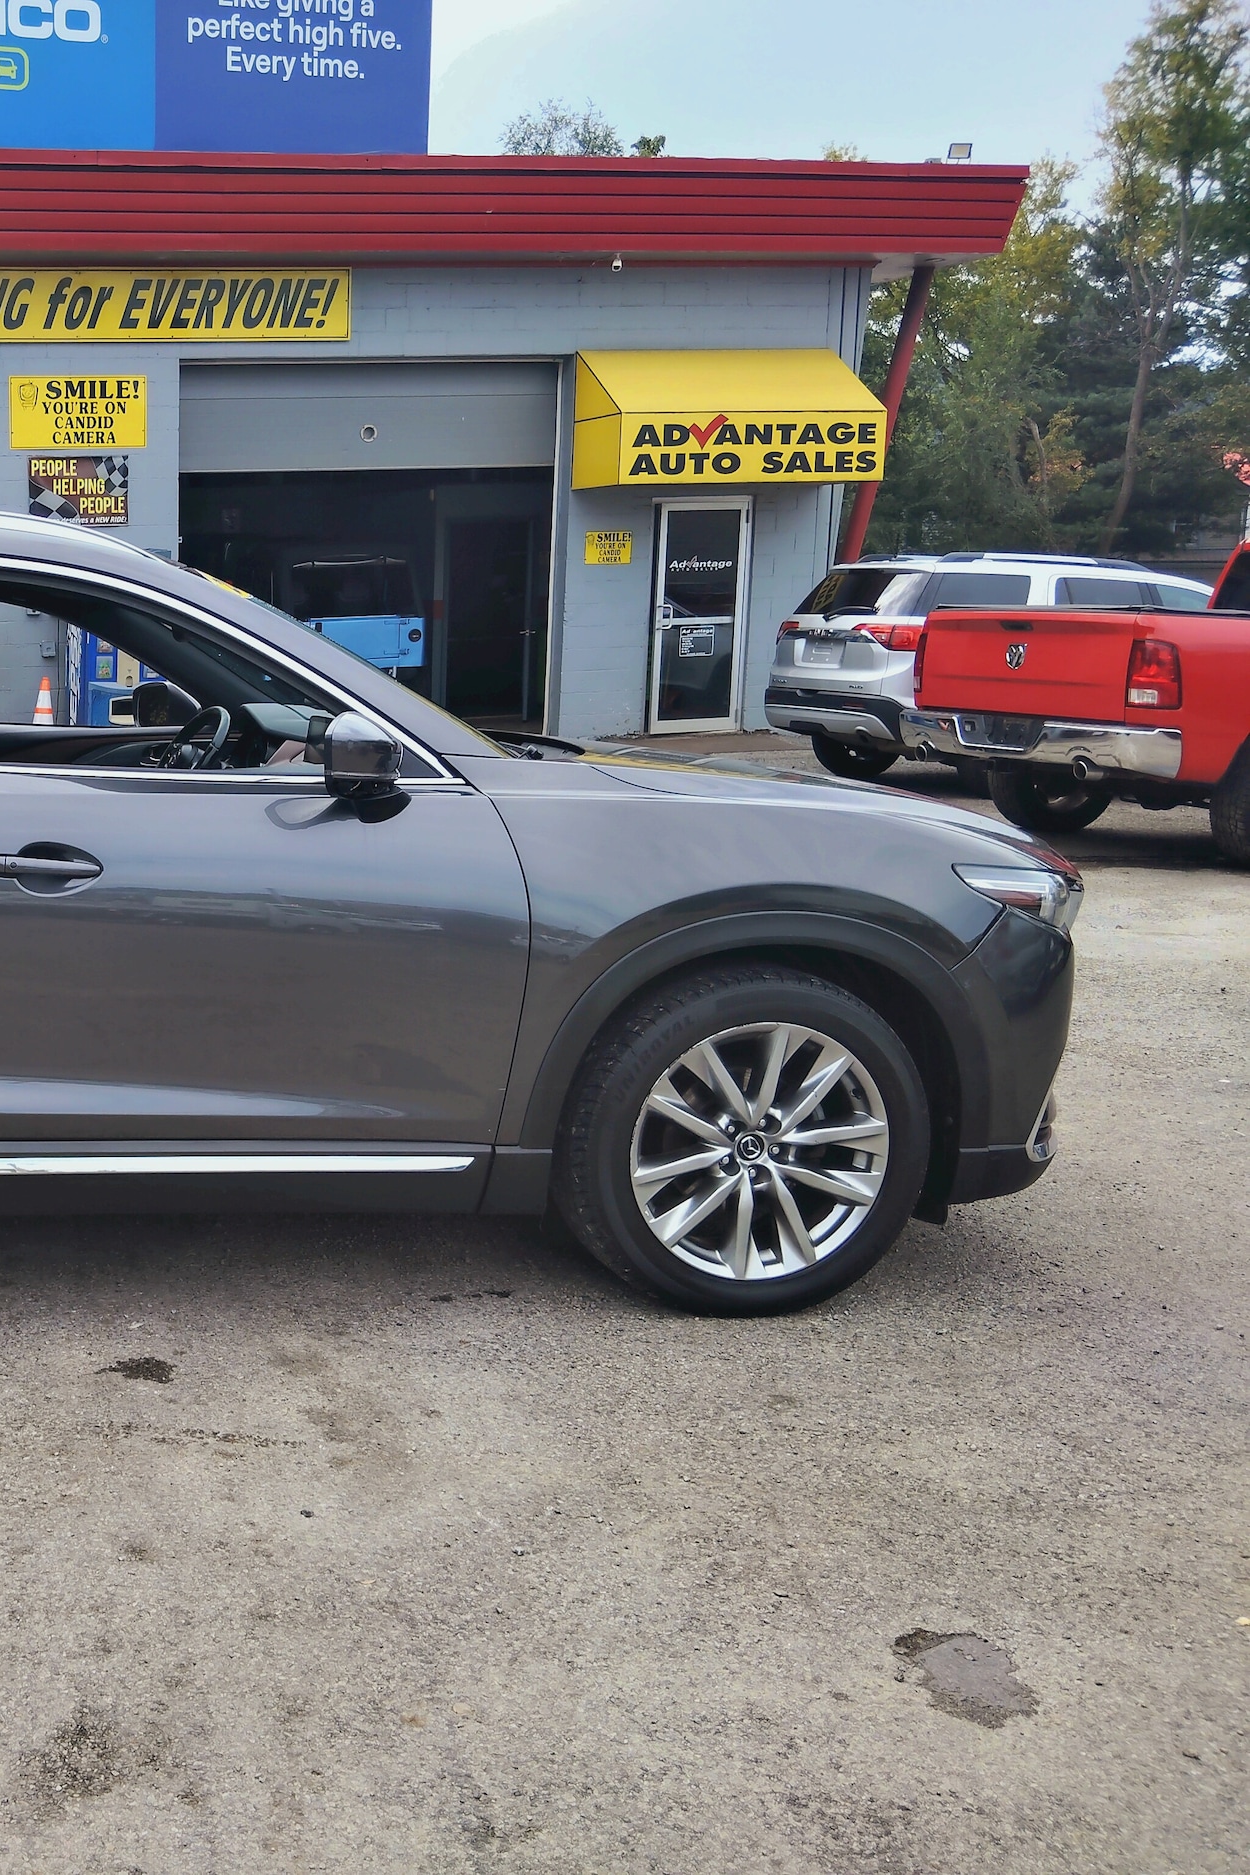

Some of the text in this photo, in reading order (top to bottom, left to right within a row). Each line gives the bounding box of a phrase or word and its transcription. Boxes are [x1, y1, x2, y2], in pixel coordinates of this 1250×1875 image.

[360, 0, 375, 17] a
[187, 13, 402, 51] perfect high five.
[226, 46, 365, 82] Every time.
[43, 277, 114, 331] for
[118, 278, 340, 329] EVERYONE!
[45, 380, 140, 400] SMILE!
[41, 401, 127, 415] YOU'RE ON
[54, 416, 114, 429] CANDID
[52, 431, 117, 444] CAMERA
[632, 414, 878, 449] ADVANTAGE
[31, 459, 78, 477] PEOPLE
[628, 450, 878, 476] AUTO SALES
[53, 479, 106, 495] HELPING
[79, 497, 126, 514] PEOPLE
[95, 516, 110, 524] NEW
[596, 532, 631, 542] SMILE!
